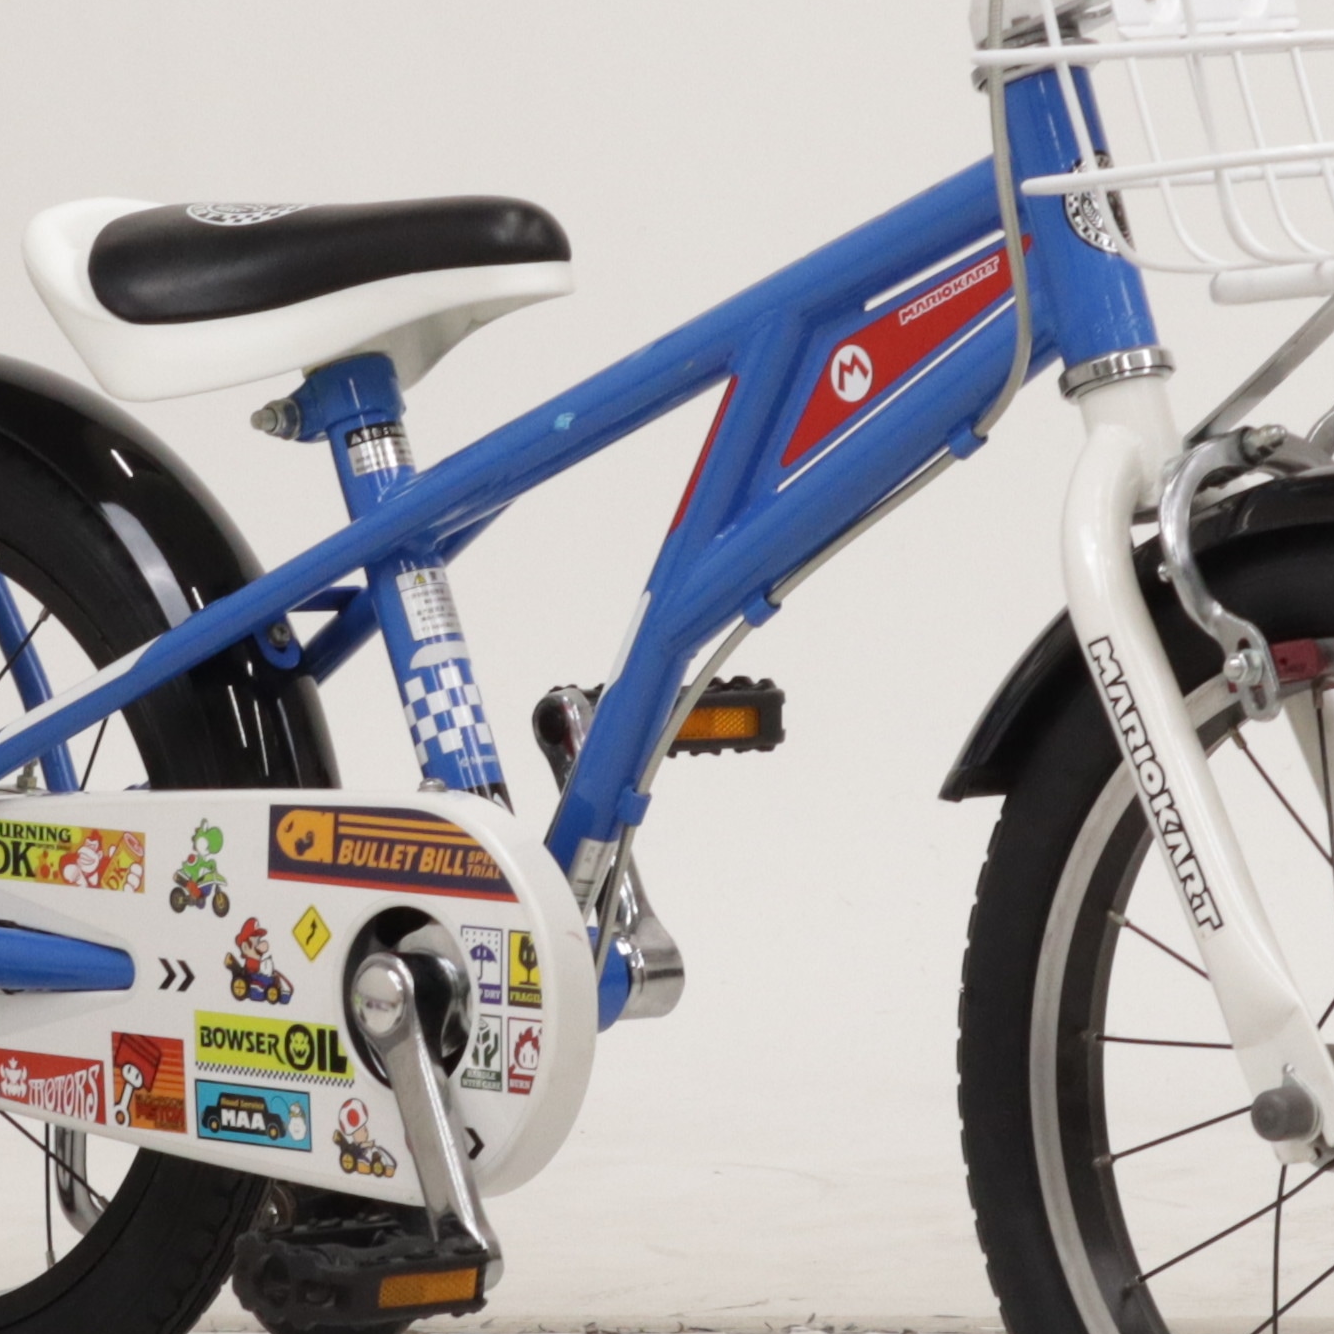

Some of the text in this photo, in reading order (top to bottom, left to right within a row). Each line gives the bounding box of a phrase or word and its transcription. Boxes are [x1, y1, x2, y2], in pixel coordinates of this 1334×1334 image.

[837, 351, 870, 393] M
[337, 839, 465, 876] BULLET BILL
[466, 864, 501, 880] TRIAL
[200, 1023, 348, 1074] BOWSER OIL
[28, 1063, 100, 1123] MOTORS
[221, 1108, 266, 1131] MAA
